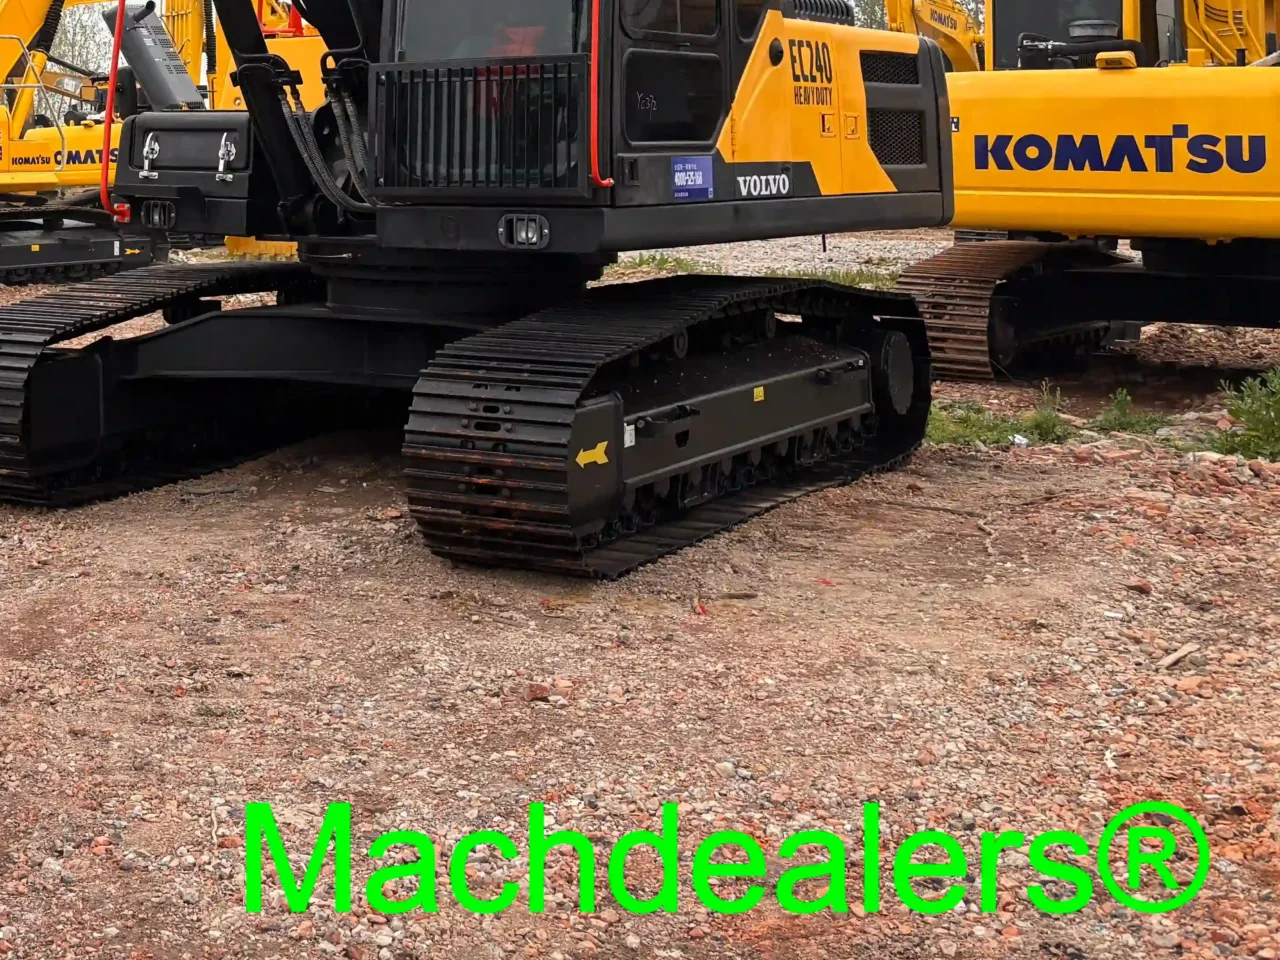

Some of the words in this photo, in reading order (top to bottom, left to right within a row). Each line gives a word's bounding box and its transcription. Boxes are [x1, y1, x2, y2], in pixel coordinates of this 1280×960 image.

[930, 7, 957, 31] KOMATSU
[788, 39, 832, 84] EC240
[793, 86, 815, 106] HEAVY
[815, 86, 833, 107] DUTY
[11, 154, 50, 165] KOMATSU
[974, 124, 1266, 174] KOMATSU
[736, 174, 790, 196] VOLVO
